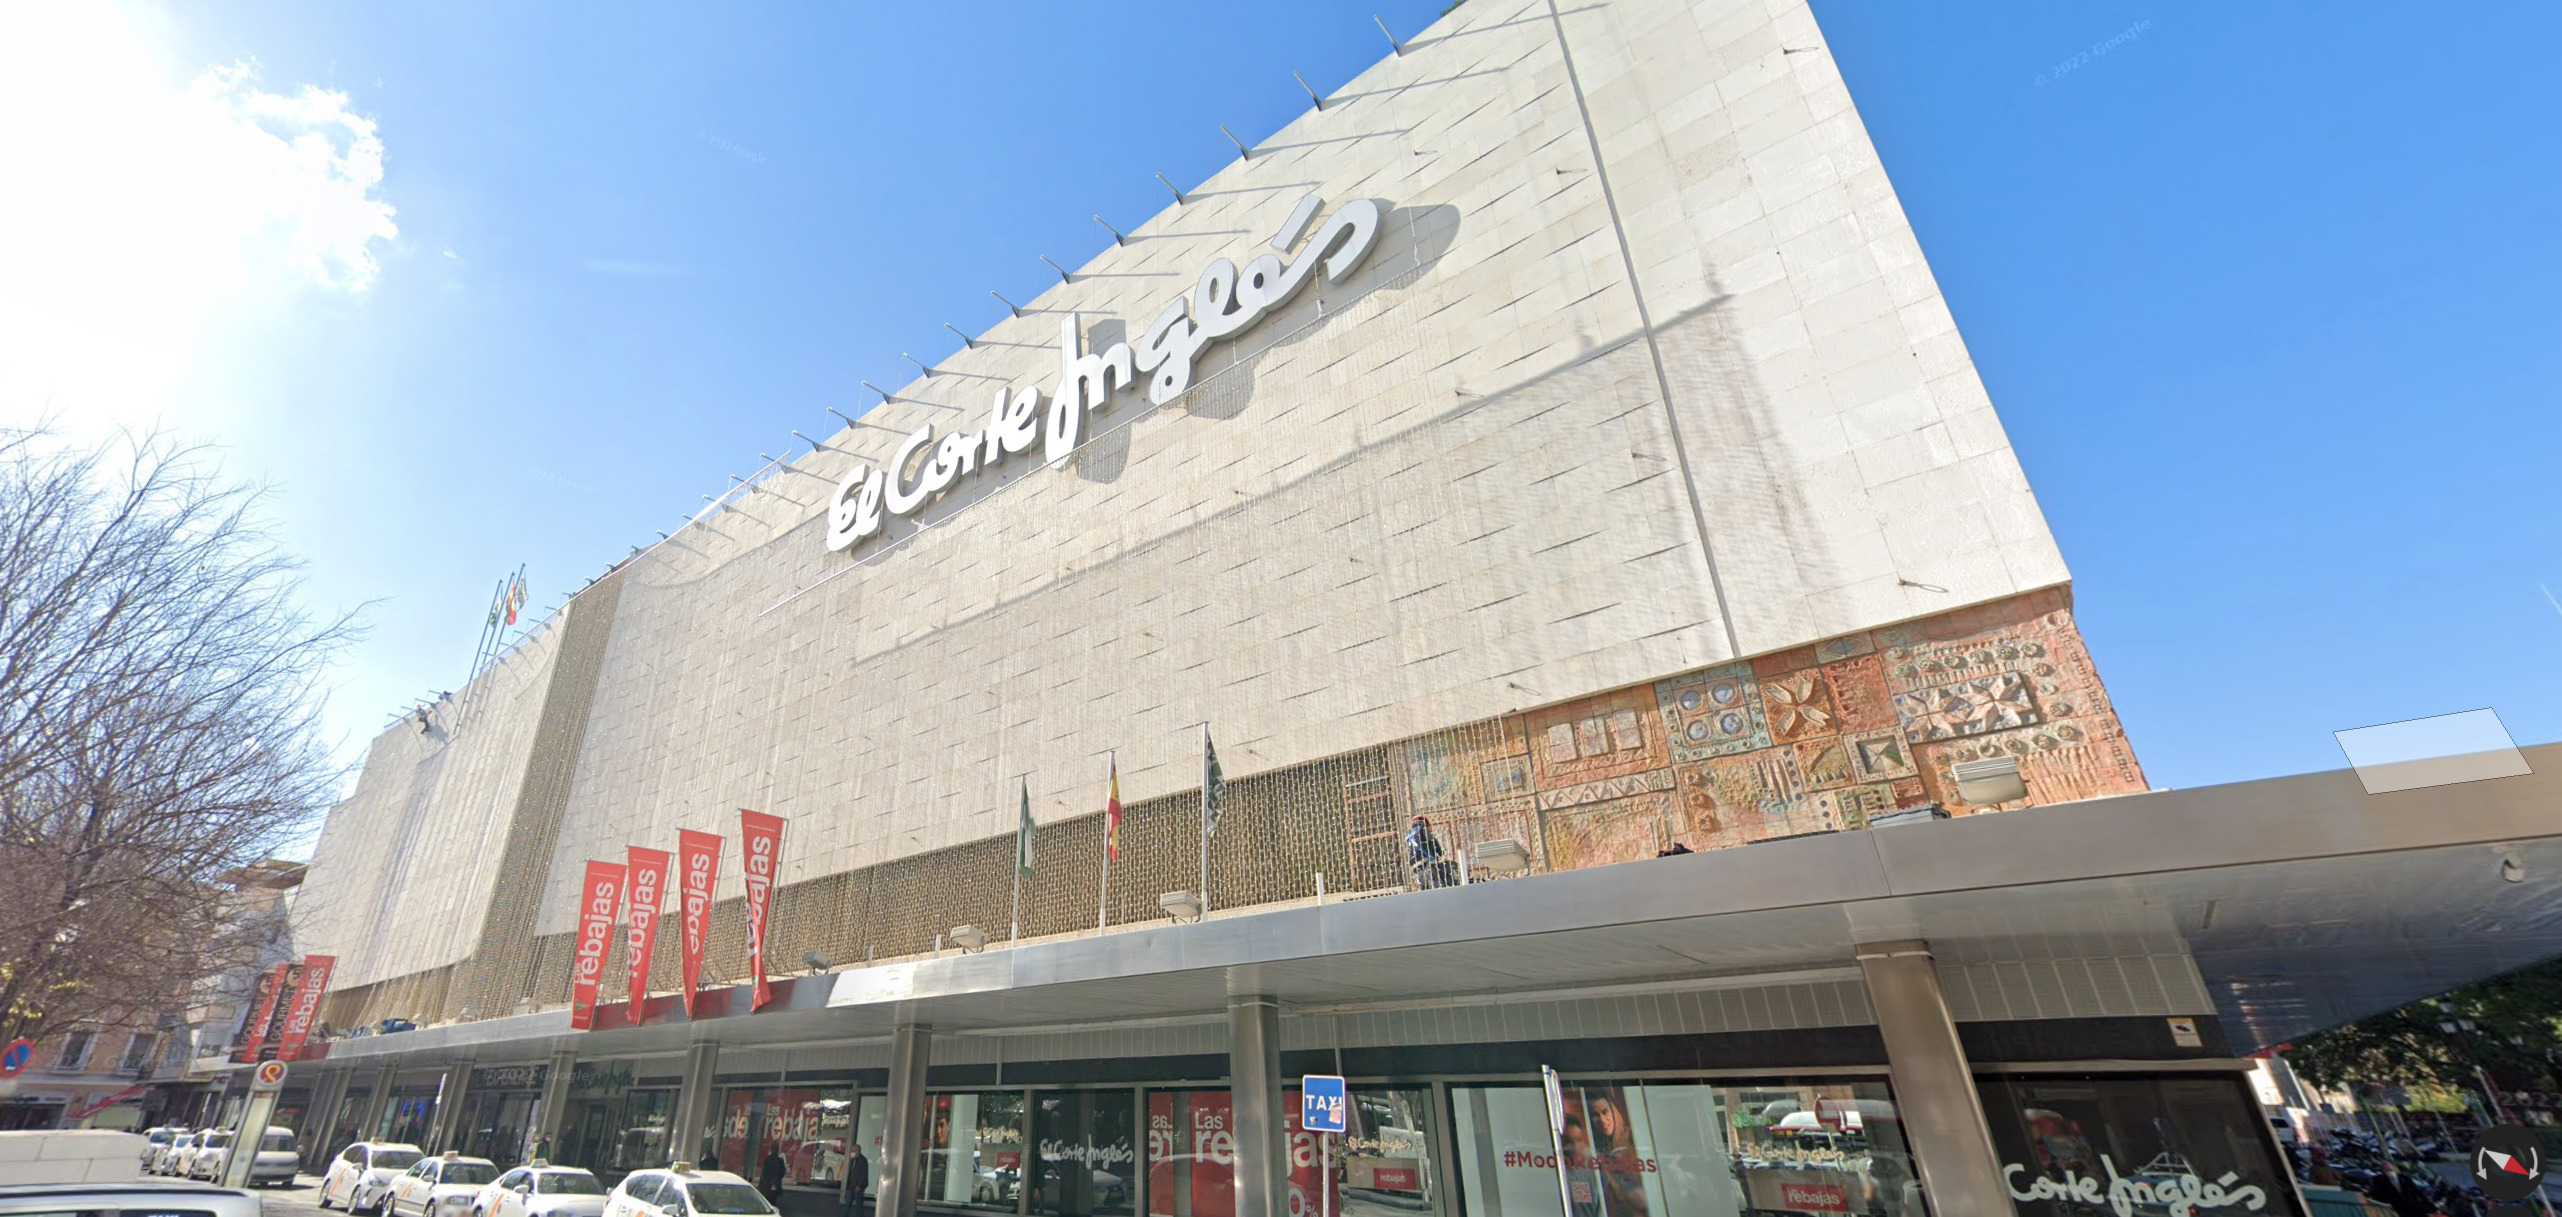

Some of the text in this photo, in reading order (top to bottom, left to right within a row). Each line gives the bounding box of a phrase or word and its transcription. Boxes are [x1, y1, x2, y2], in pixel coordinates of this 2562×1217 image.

[826, 193, 1384, 552] El Corte Inglés
[578, 882, 615, 986] rebajas
[295, 967, 326, 1034] rebajas
[1195, 1112, 1224, 1130] Las
[1306, 1094, 1342, 1111] TAXI
[1053, 1139, 1085, 1162] Corte
[1085, 1134, 1134, 1170] Inglés
[1788, 1190, 1840, 1206] rebajas
[2003, 1154, 2267, 1217] Corte Inglés
